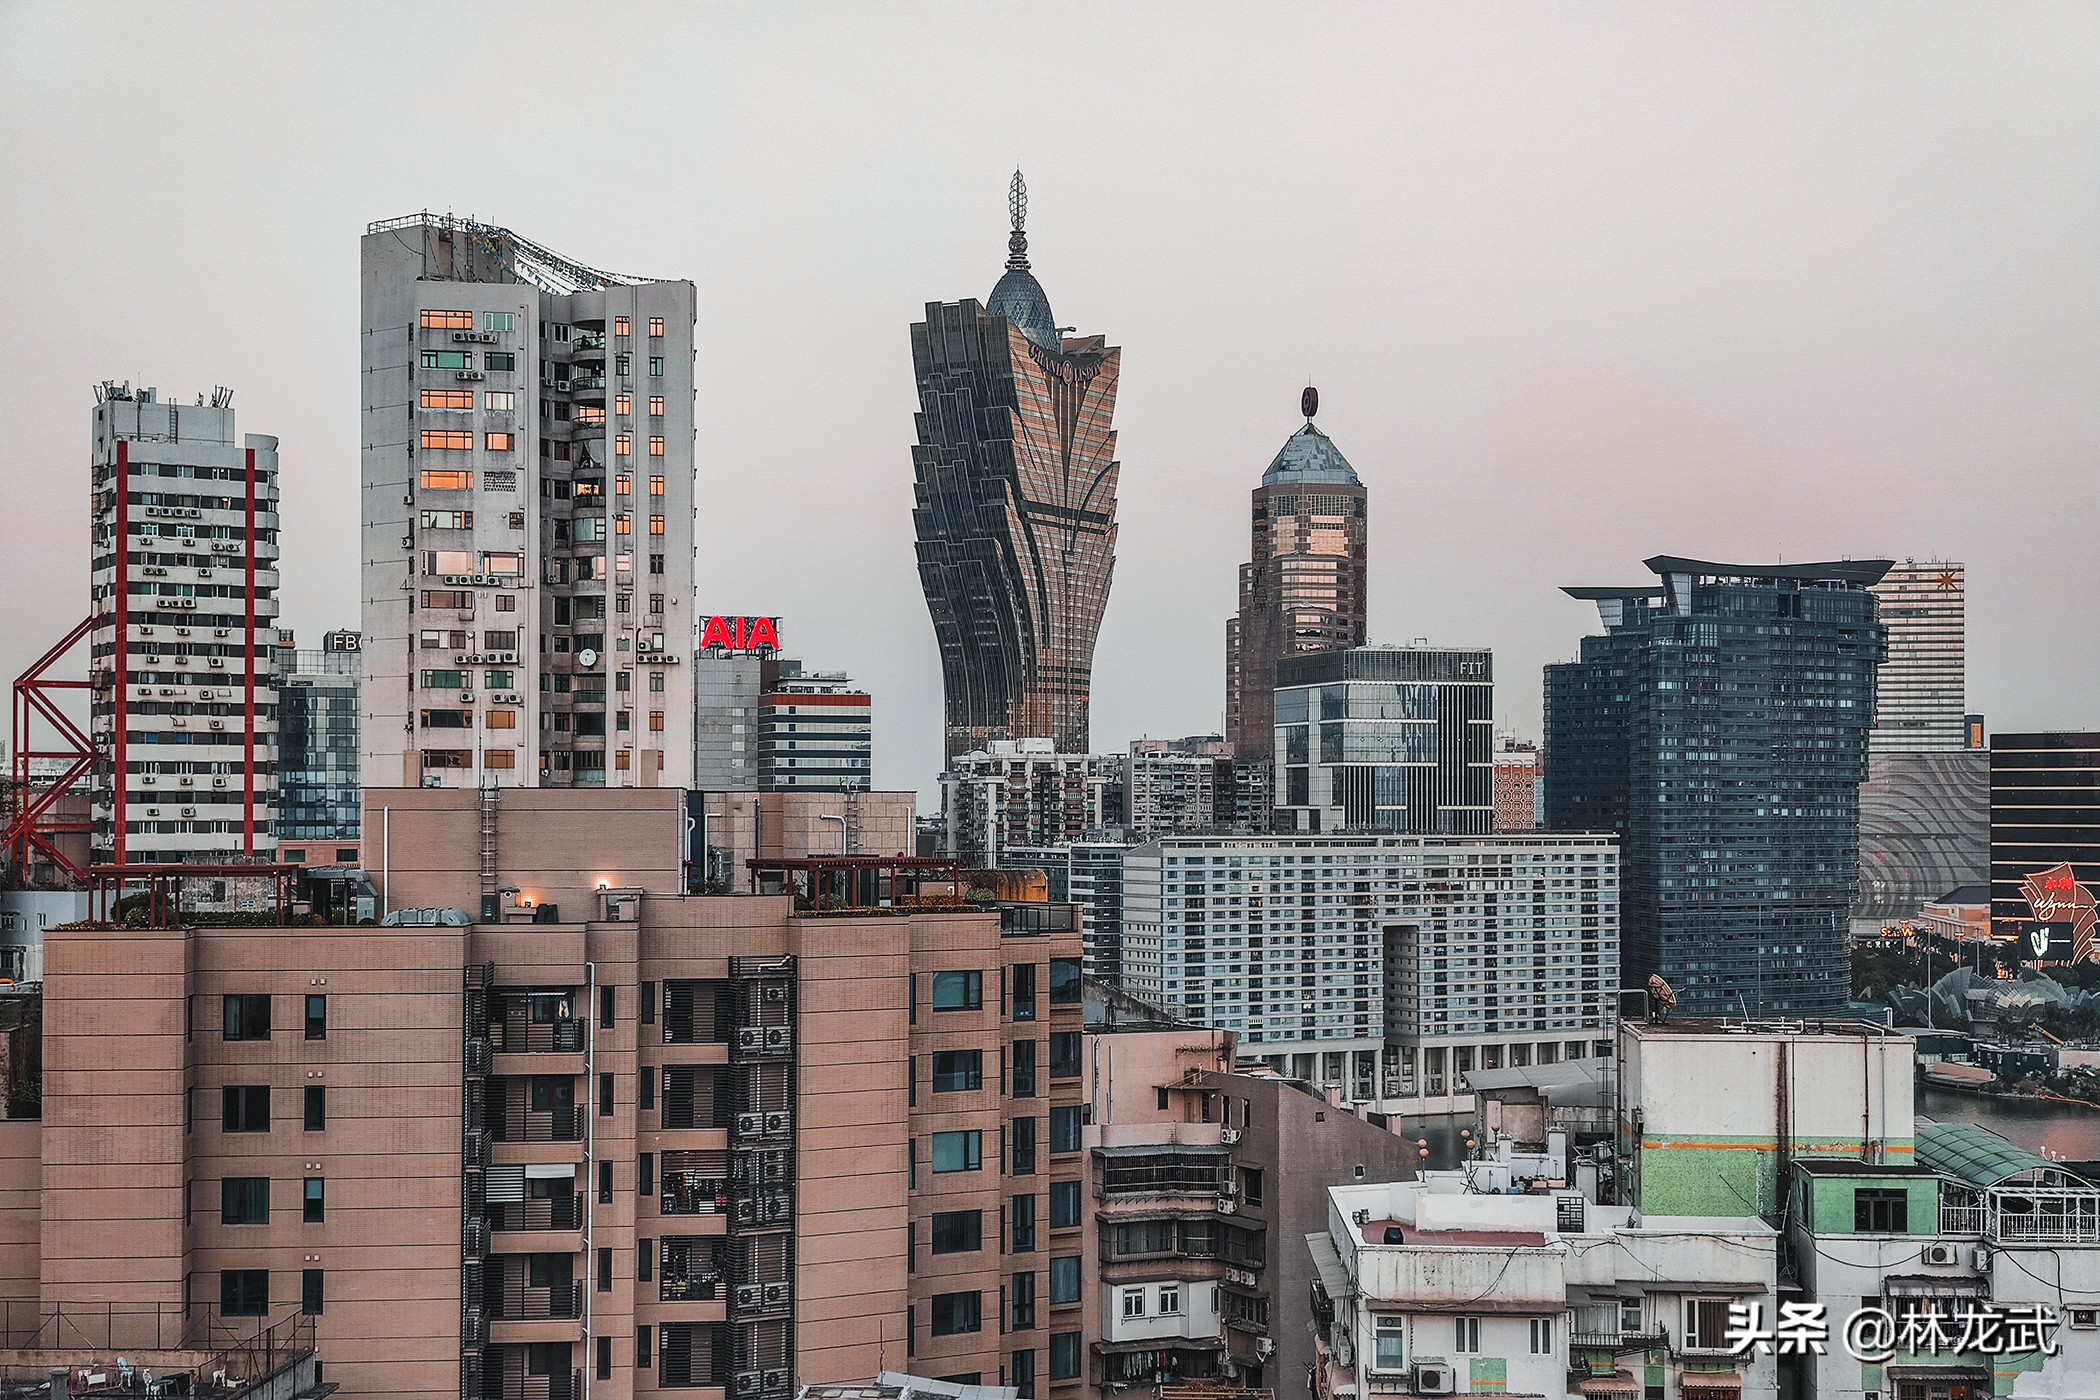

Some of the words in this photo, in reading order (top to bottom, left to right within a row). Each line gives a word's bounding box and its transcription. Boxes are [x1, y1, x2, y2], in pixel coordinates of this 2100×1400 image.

[1030, 345, 1062, 377] GRAND
[701, 615, 779, 649] AIA
[1461, 662, 1483, 674] FIT
